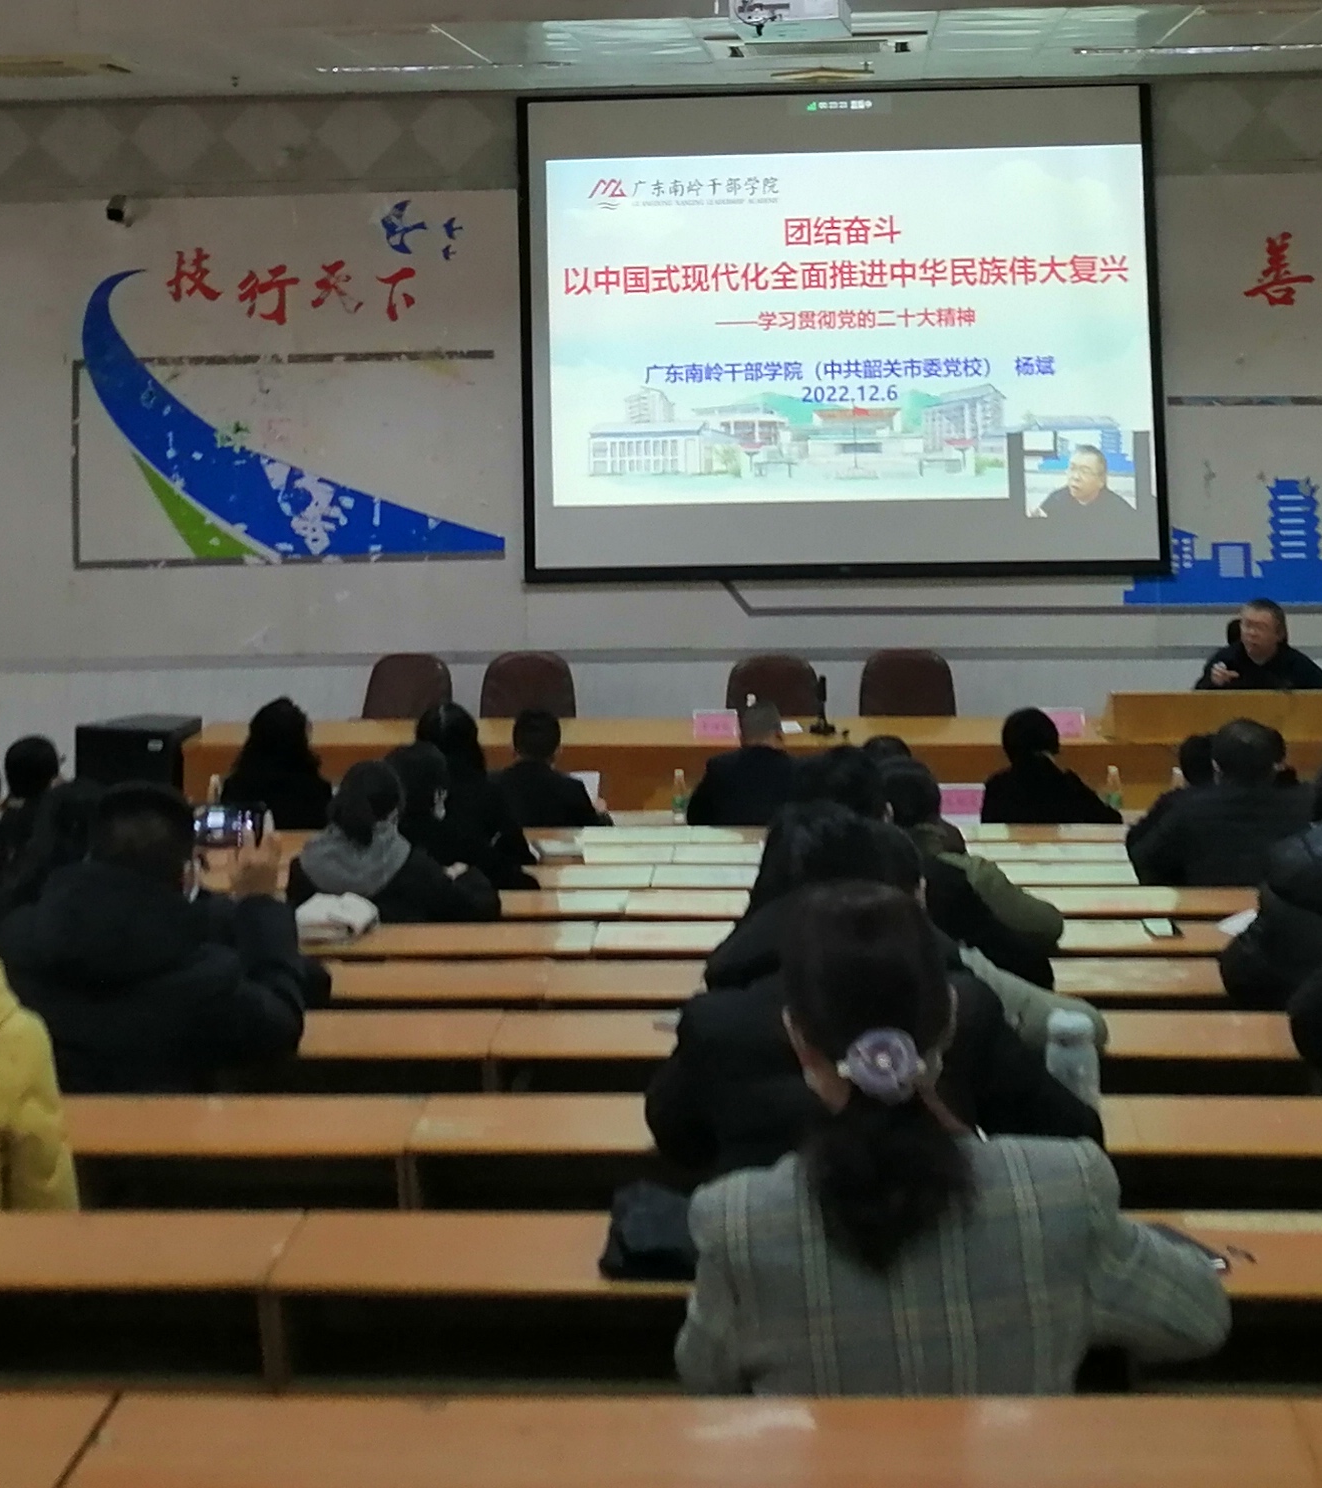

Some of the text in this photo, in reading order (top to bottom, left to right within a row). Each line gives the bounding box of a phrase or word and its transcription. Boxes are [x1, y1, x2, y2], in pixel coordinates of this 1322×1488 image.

[784, 215, 902, 246] 团结奋斗
[166, 247, 417, 326] 技行天下
[563, 254, 1130, 296] 以中国式现代化全面推进中华民族伟大复兴
[1014, 355, 1056, 376] 杨斌
[801, 385, 898, 403] 2022.12.6
